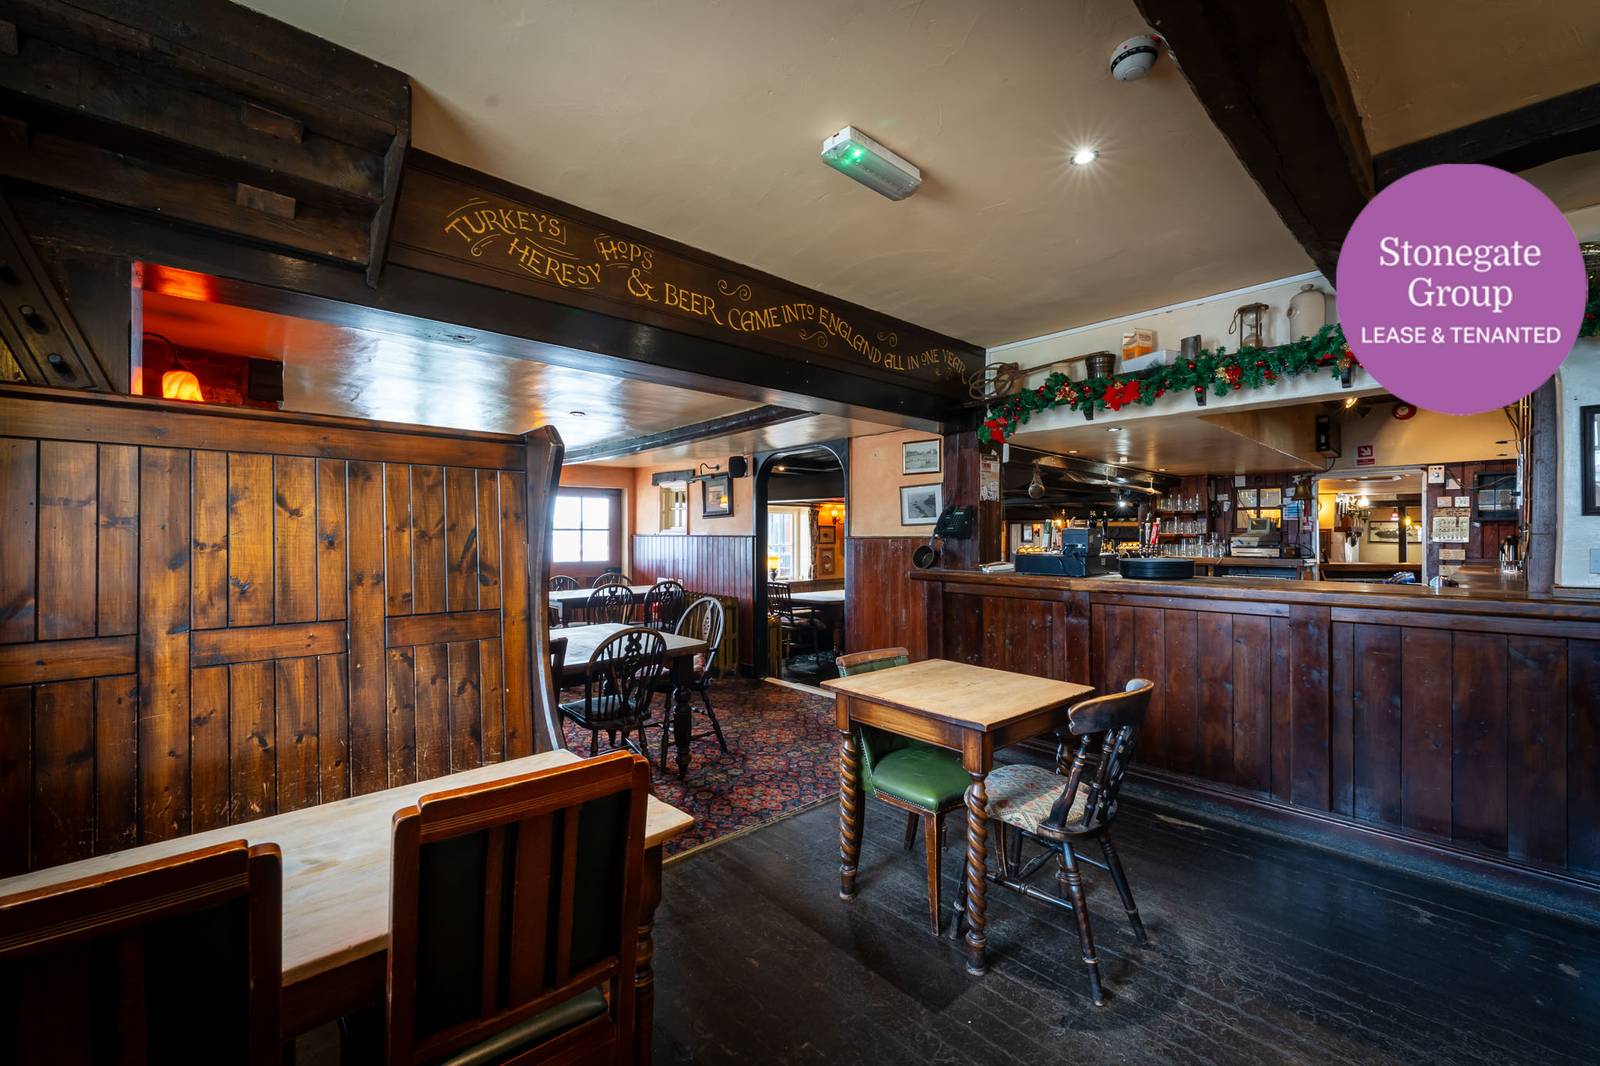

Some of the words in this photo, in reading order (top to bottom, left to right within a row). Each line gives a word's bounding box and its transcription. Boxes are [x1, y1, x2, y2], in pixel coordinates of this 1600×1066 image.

[444, 208, 561, 242] TURKEYS
[508, 237, 601, 287] HERESY
[599, 240, 653, 270] HOPS
[627, 267, 658, 302] &
[664, 282, 724, 326] BEER
[727, 307, 782, 332] CAME
[781, 303, 815, 325] INTO
[818, 307, 882, 364] ENGLAND
[884, 353, 905, 371] ALL
[907, 354, 920, 370] IN
[920, 348, 940, 366] ONE
[942, 348, 967, 385] YEAR
